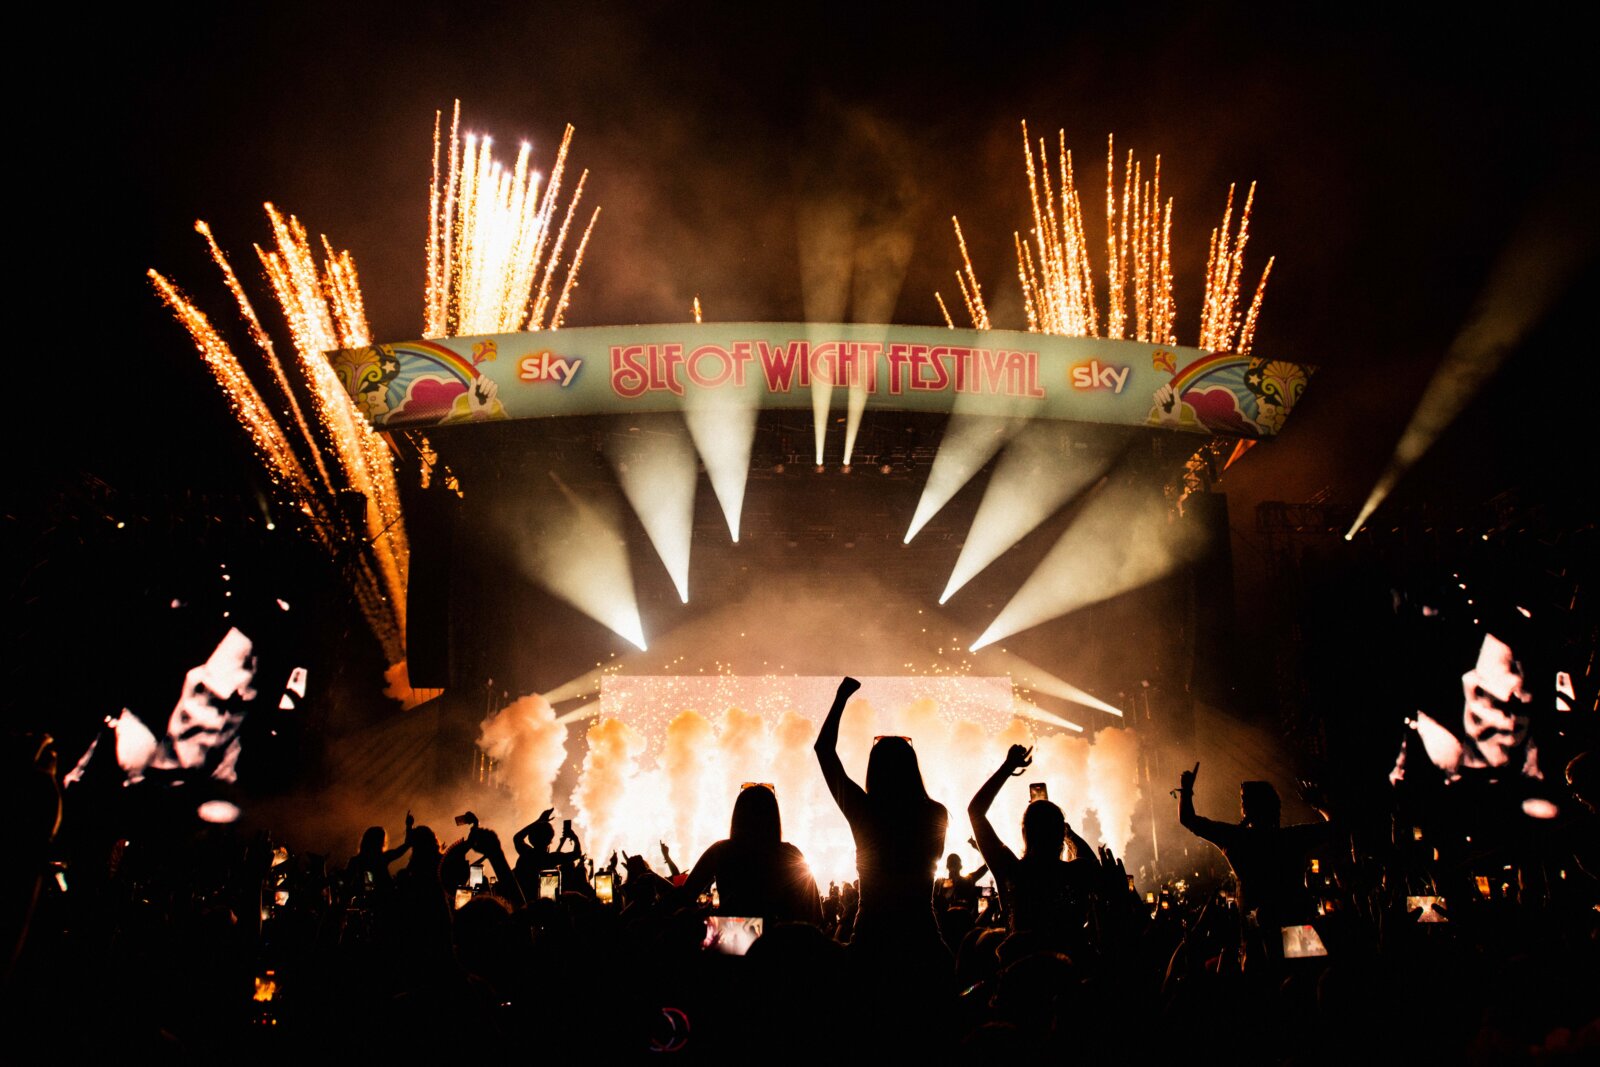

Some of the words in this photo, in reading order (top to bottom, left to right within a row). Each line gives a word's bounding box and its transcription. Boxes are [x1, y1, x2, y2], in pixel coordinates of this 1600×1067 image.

[520, 352, 582, 387] sky
[609, 343, 685, 397] ISLE
[686, 341, 756, 388] OF
[757, 340, 884, 394] WIGHT
[885, 343, 1046, 399] FESTIVAL
[1071, 361, 1131, 394] sky
